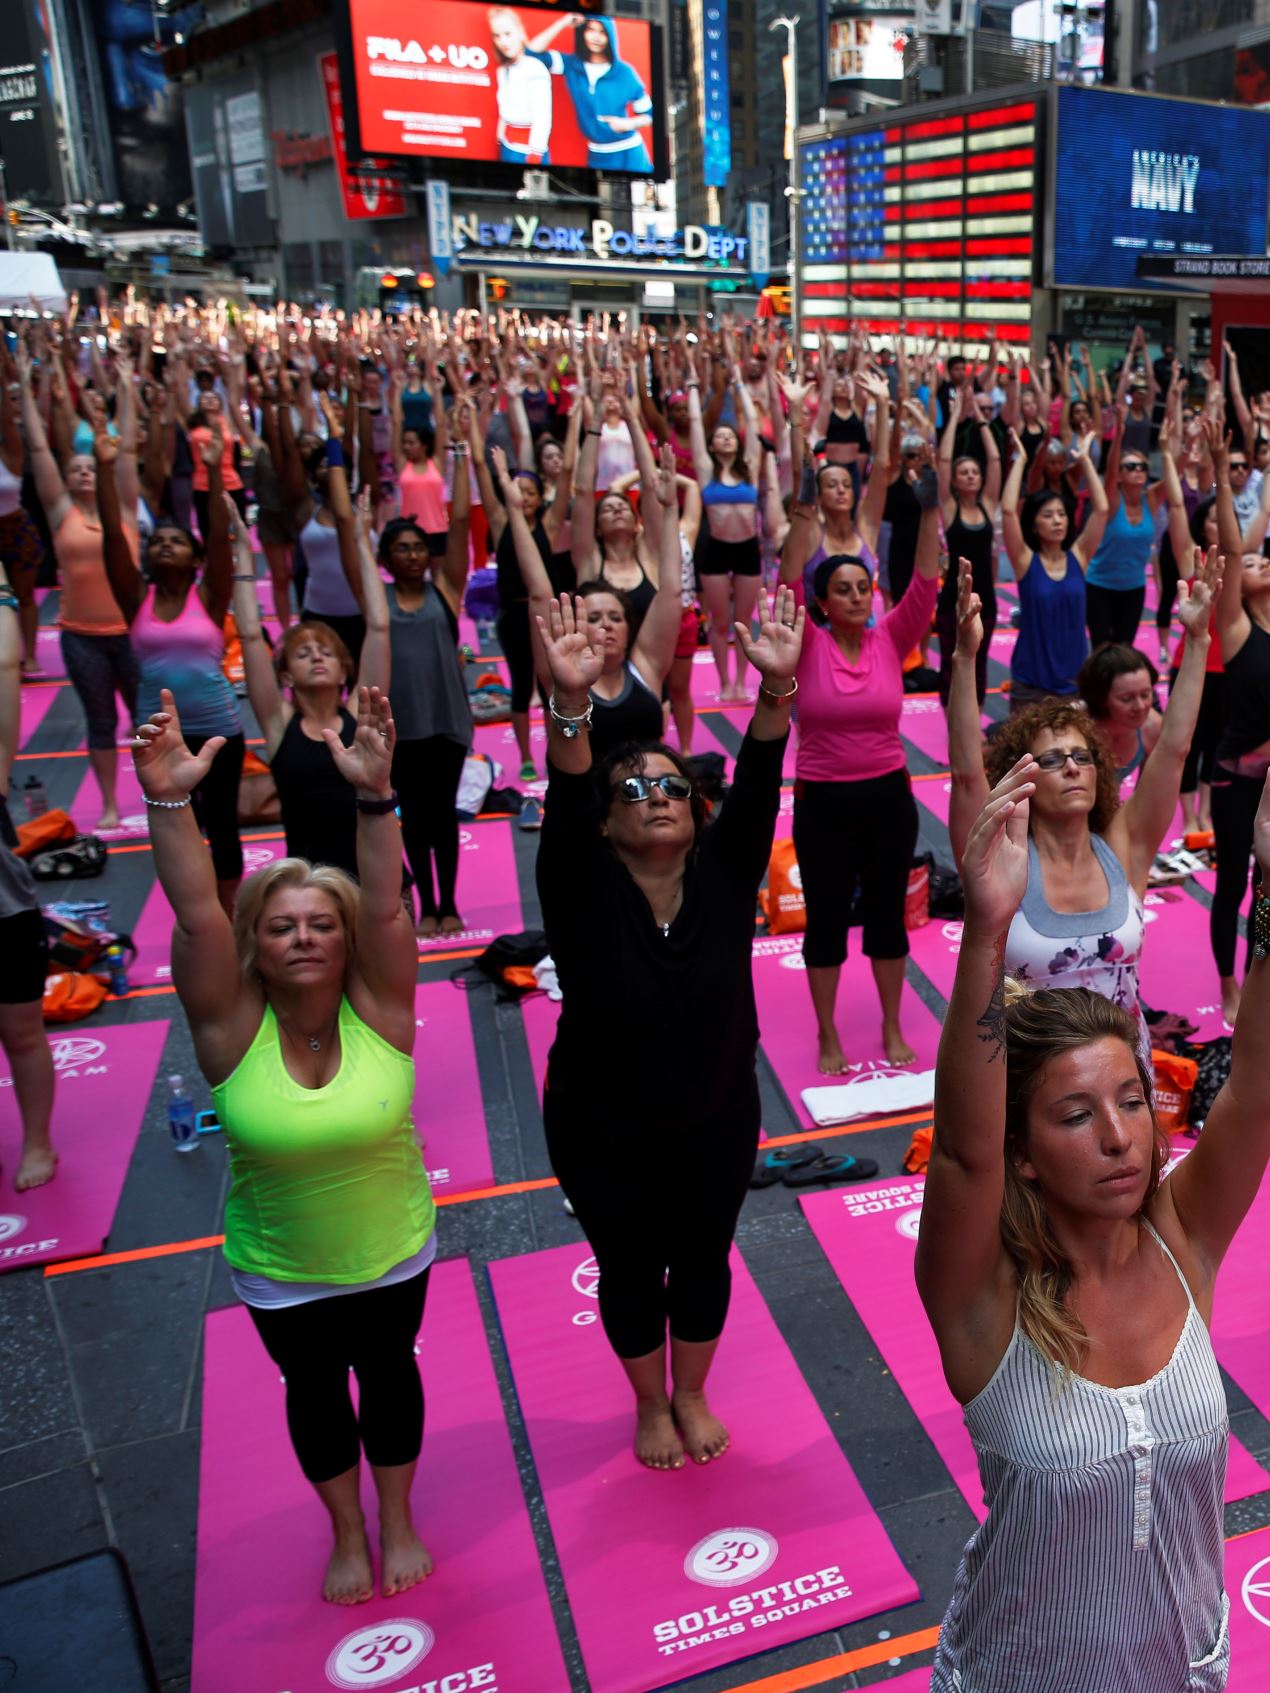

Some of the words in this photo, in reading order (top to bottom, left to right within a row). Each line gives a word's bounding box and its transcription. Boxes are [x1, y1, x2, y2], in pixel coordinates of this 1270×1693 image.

[447, 44, 489, 69] UO
[1131, 162, 1199, 213] NAVY
[1174, 260, 1211, 274] STRAND
[1211, 261, 1237, 274] BOOK
[847, 1191, 924, 1217] STICE
[653, 1566, 846, 1643] SOLSTICE
[658, 1621, 746, 1657] TIMES
[750, 1585, 853, 1629] SQUARE
